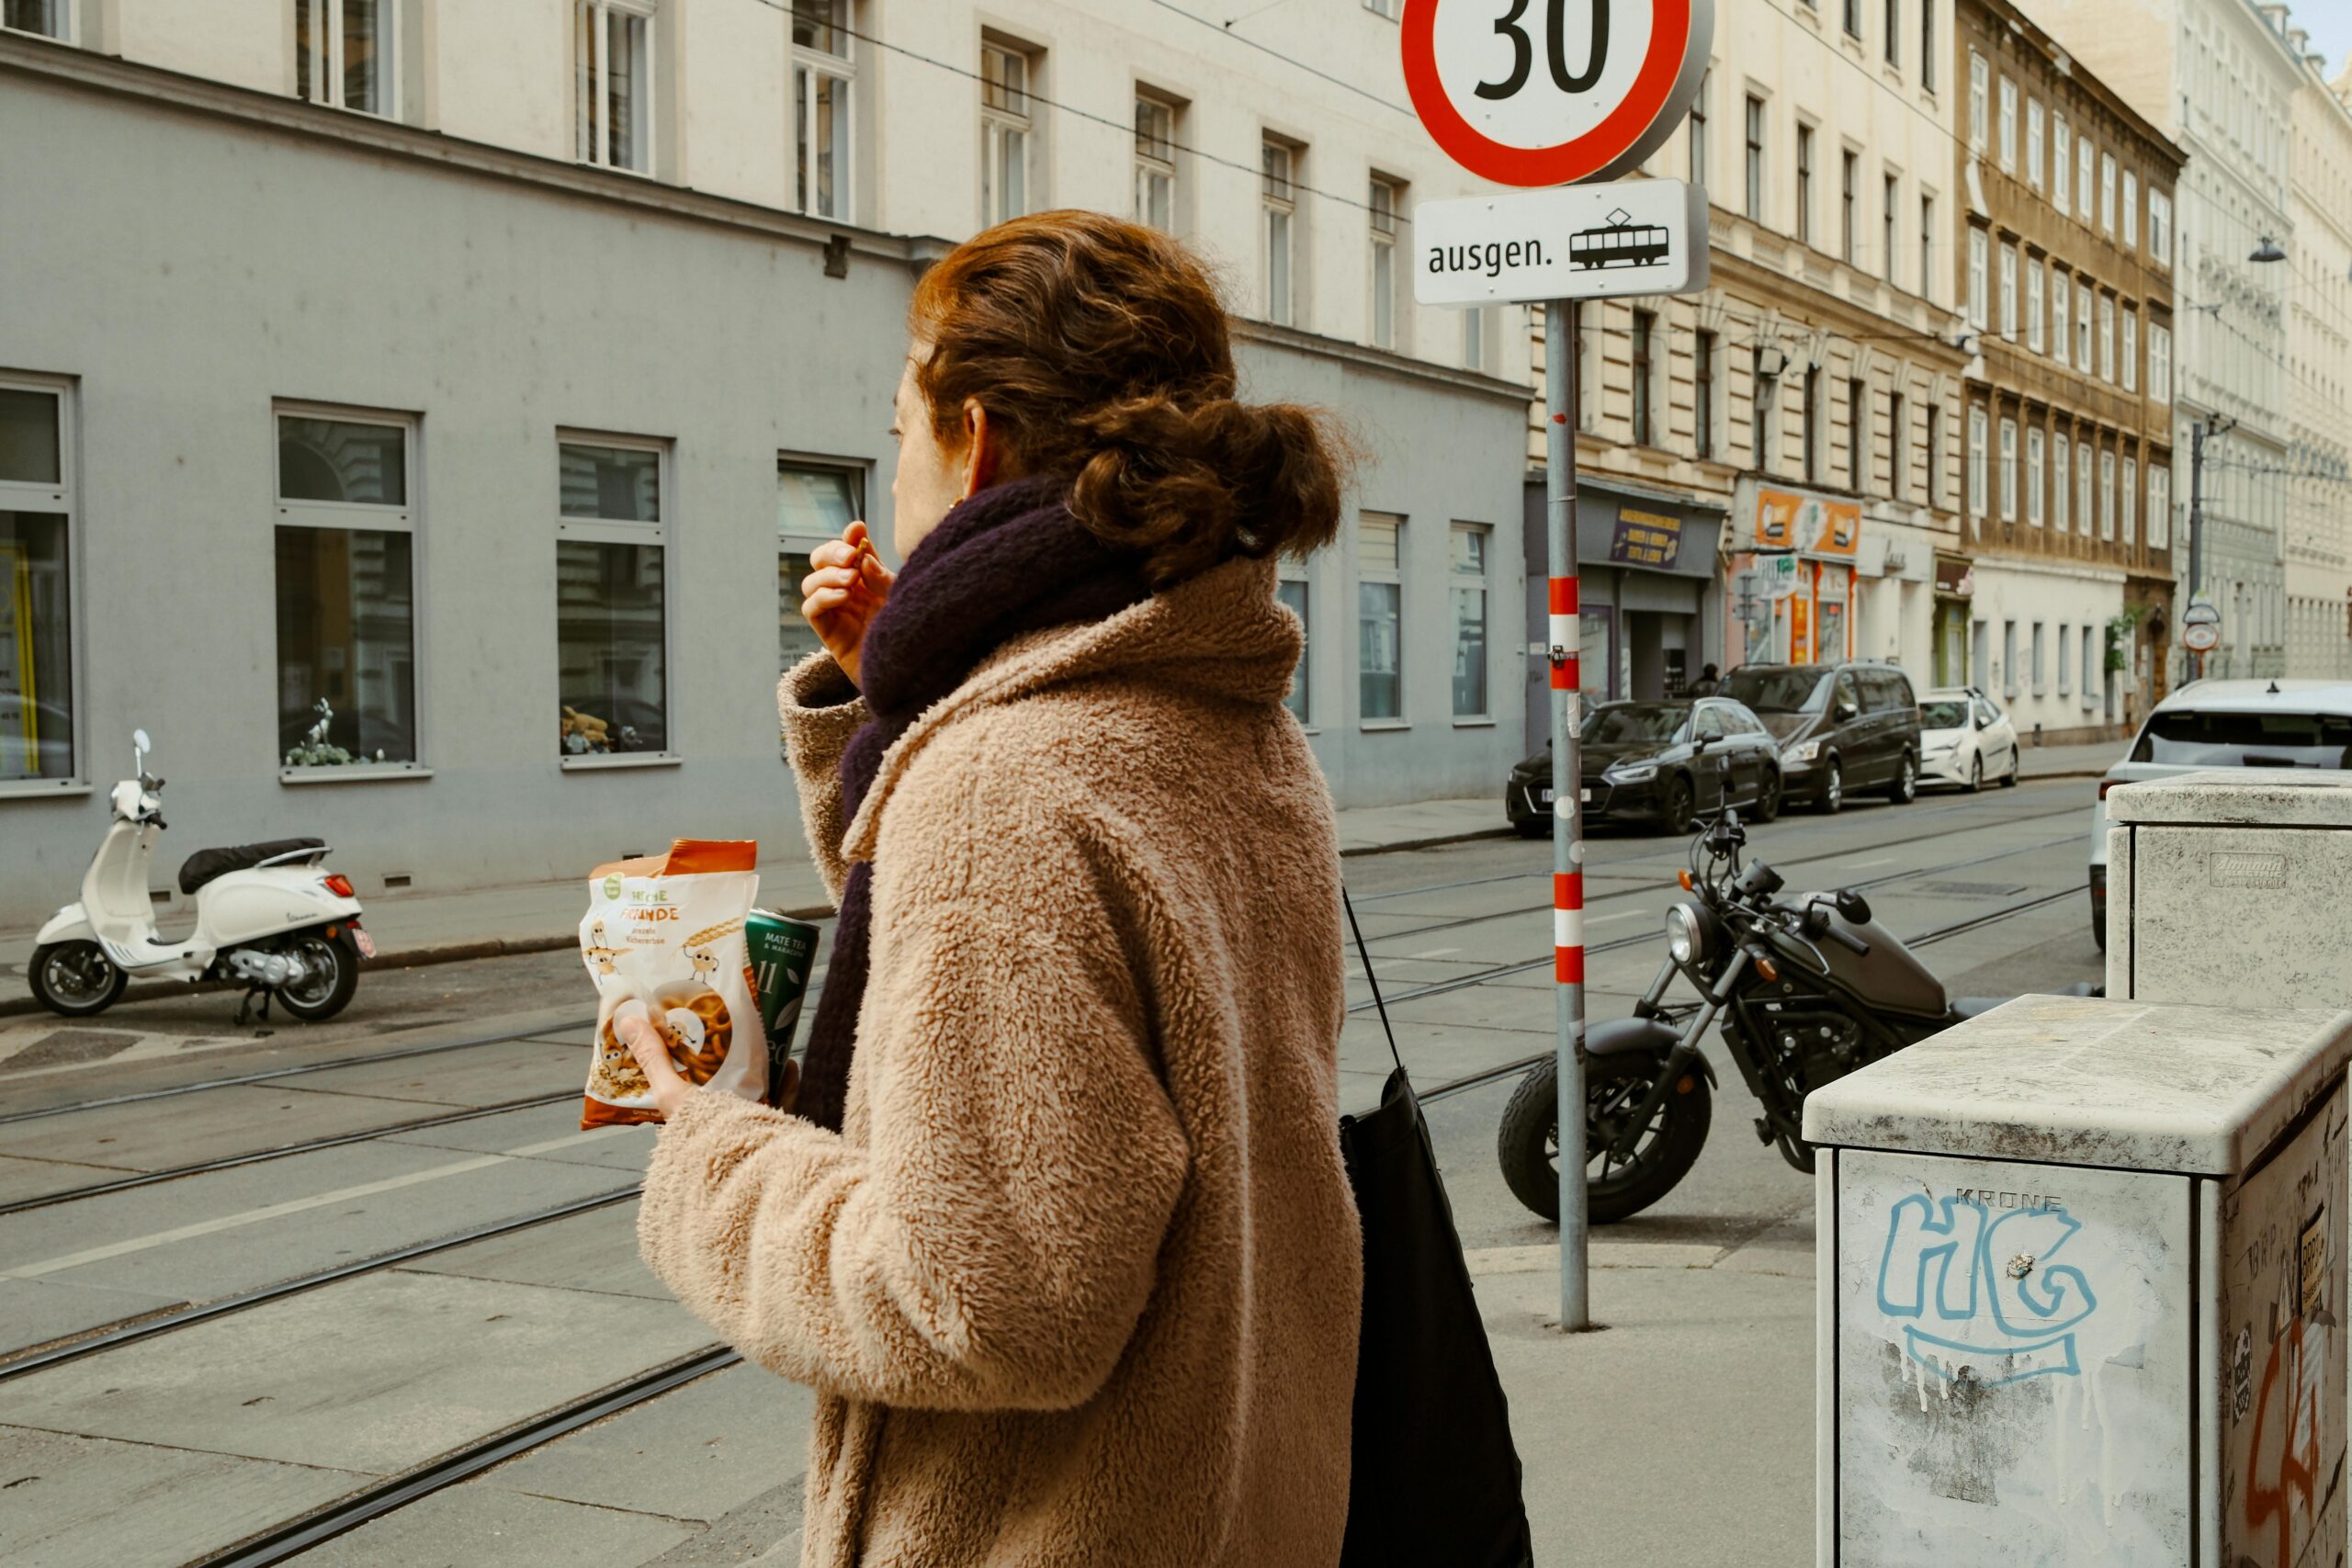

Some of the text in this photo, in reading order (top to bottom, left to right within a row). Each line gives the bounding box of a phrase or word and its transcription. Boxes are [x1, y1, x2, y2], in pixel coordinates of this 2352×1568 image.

[1474, 0, 1610, 100] 30
[1429, 239, 1553, 277] ausgen.
[764, 931, 806, 950] MATE TEA
[1955, 1188, 2062, 1213] KRONE
